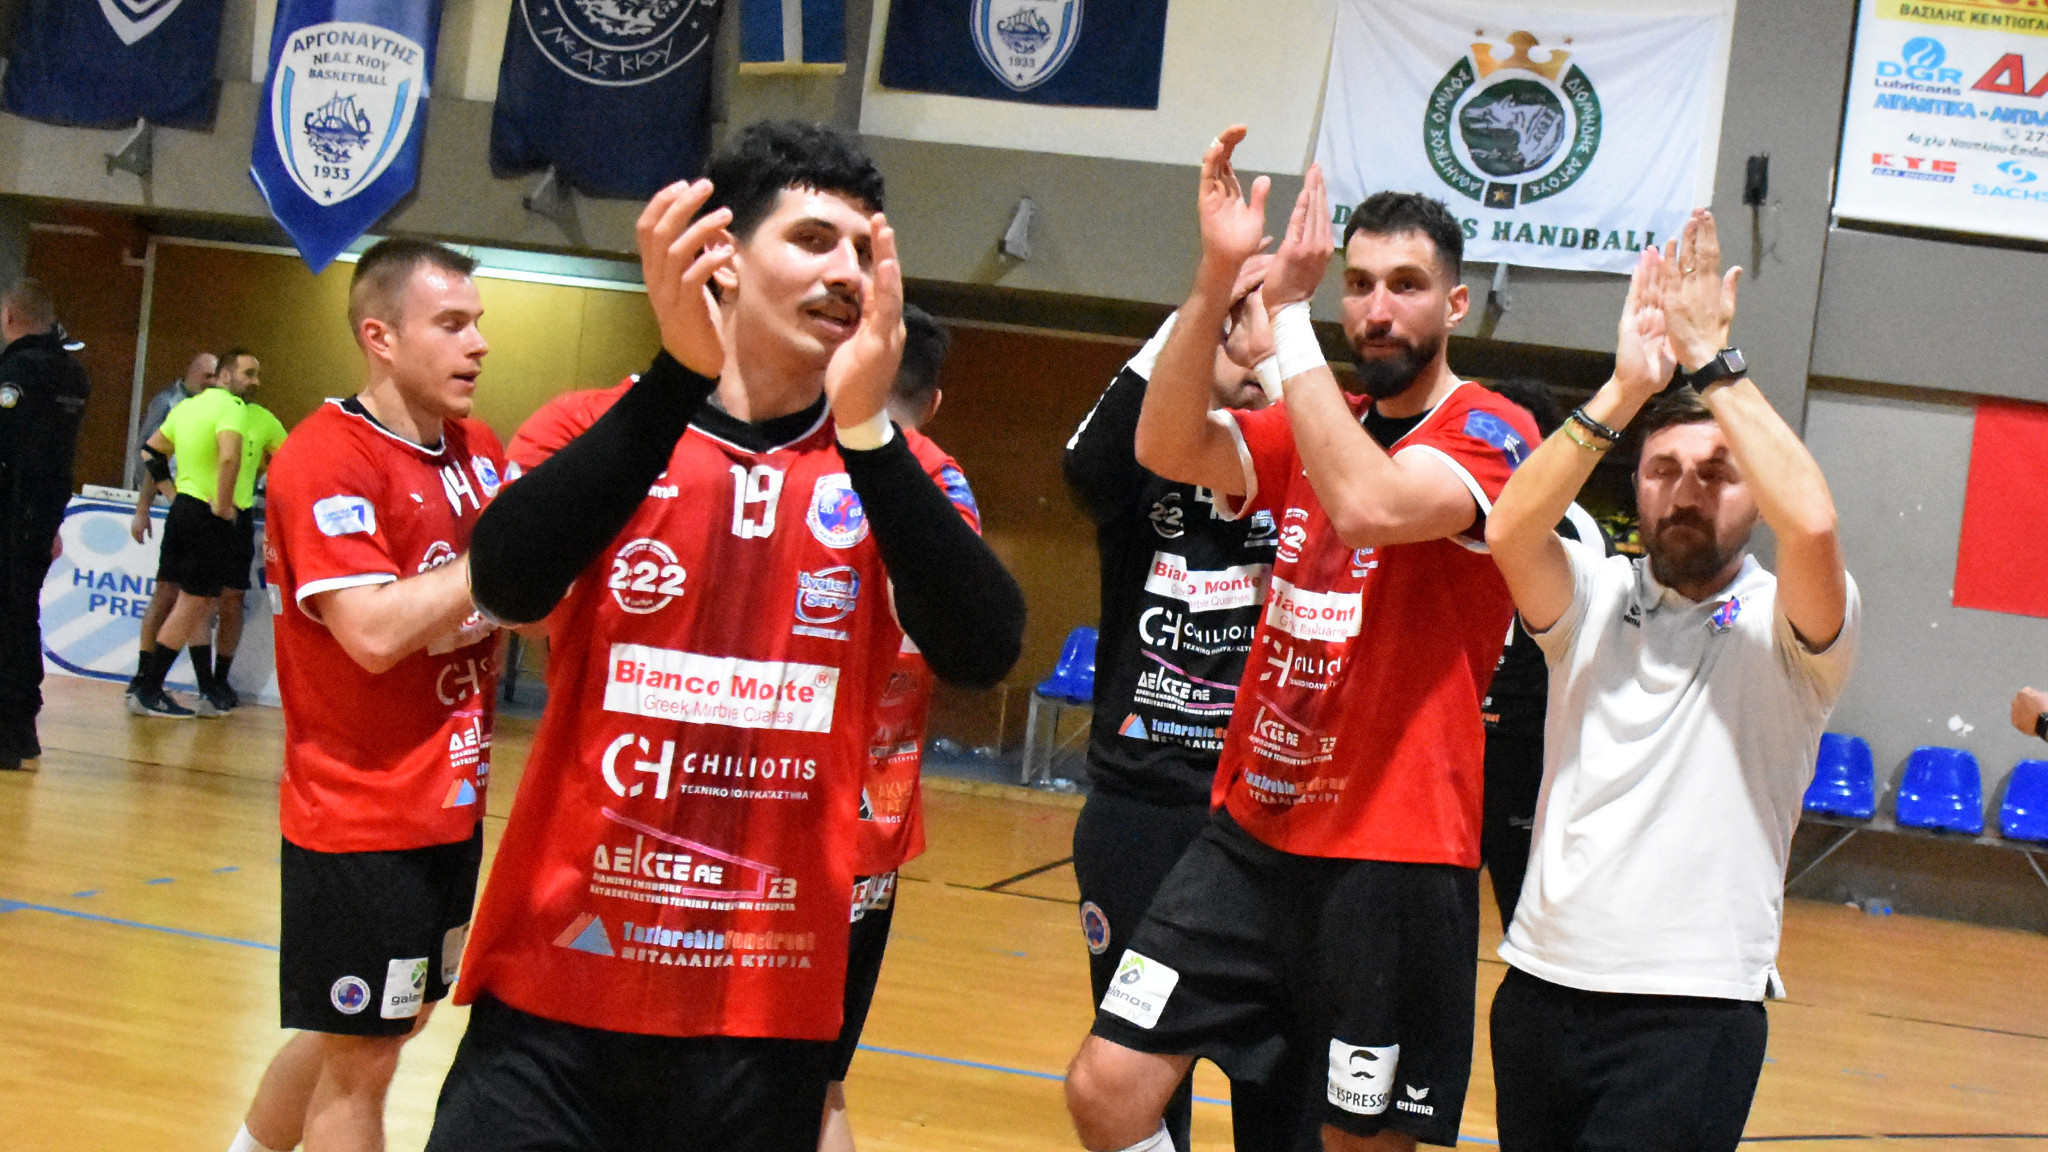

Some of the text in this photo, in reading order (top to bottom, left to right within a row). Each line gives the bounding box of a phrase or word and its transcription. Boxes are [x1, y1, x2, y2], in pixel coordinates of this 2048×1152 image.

[293, 30, 418, 65] ΑΡΓΟΝΑΥΤΗΣ
[313, 53, 390, 72] ΝΕΑΣ ΚΙΟΥ
[1876, 61, 1963, 85] DGR
[308, 68, 388, 87] BASKETBALL
[1874, 78, 1961, 96] Lubricants
[313, 165, 350, 180] 1933
[1493, 220, 1660, 254] HANDBALL
[439, 460, 481, 517] 14
[729, 464, 784, 539] 19
[615, 659, 720, 696] Bianco
[644, 695, 688, 716] Greek
[683, 752, 816, 780] CHILIOTIS
[1396, 1100, 1434, 1116] erima
